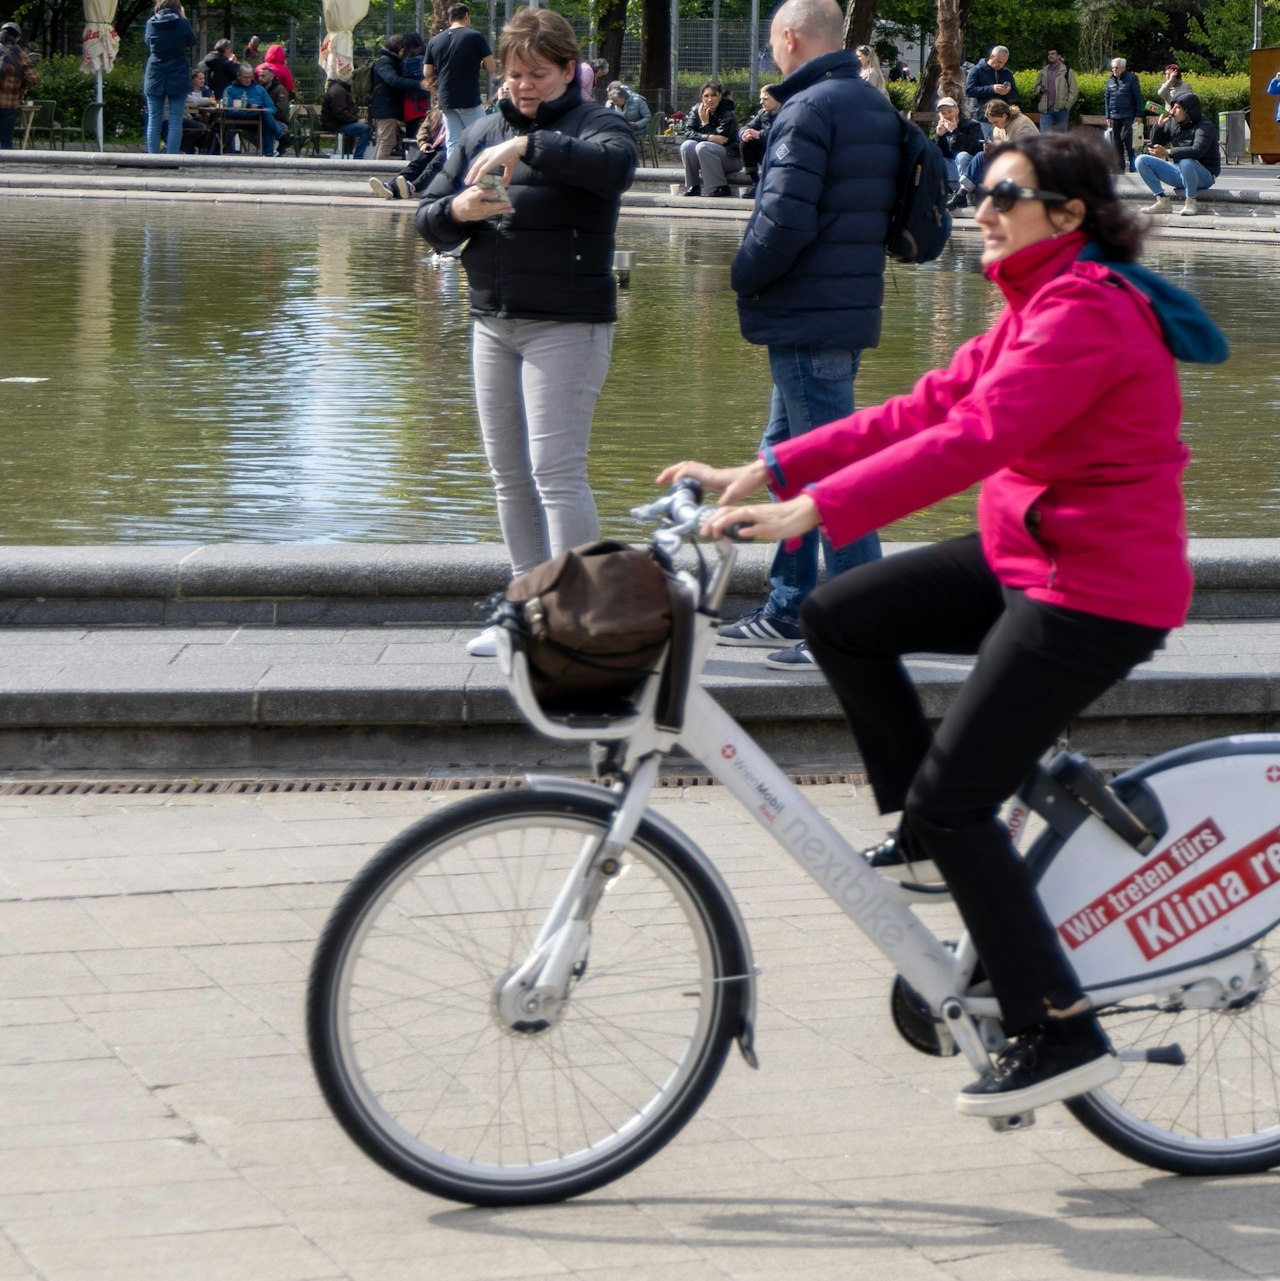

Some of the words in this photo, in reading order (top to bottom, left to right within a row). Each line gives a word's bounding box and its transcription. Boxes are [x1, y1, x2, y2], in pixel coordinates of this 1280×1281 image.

[734, 756, 787, 814] WienMobil
[782, 817, 904, 948] nextbike
[1065, 905, 1109, 942] Wir
[1107, 860, 1174, 913] treten
[1170, 828, 1217, 868] fürs
[1136, 870, 1249, 952] Klima
